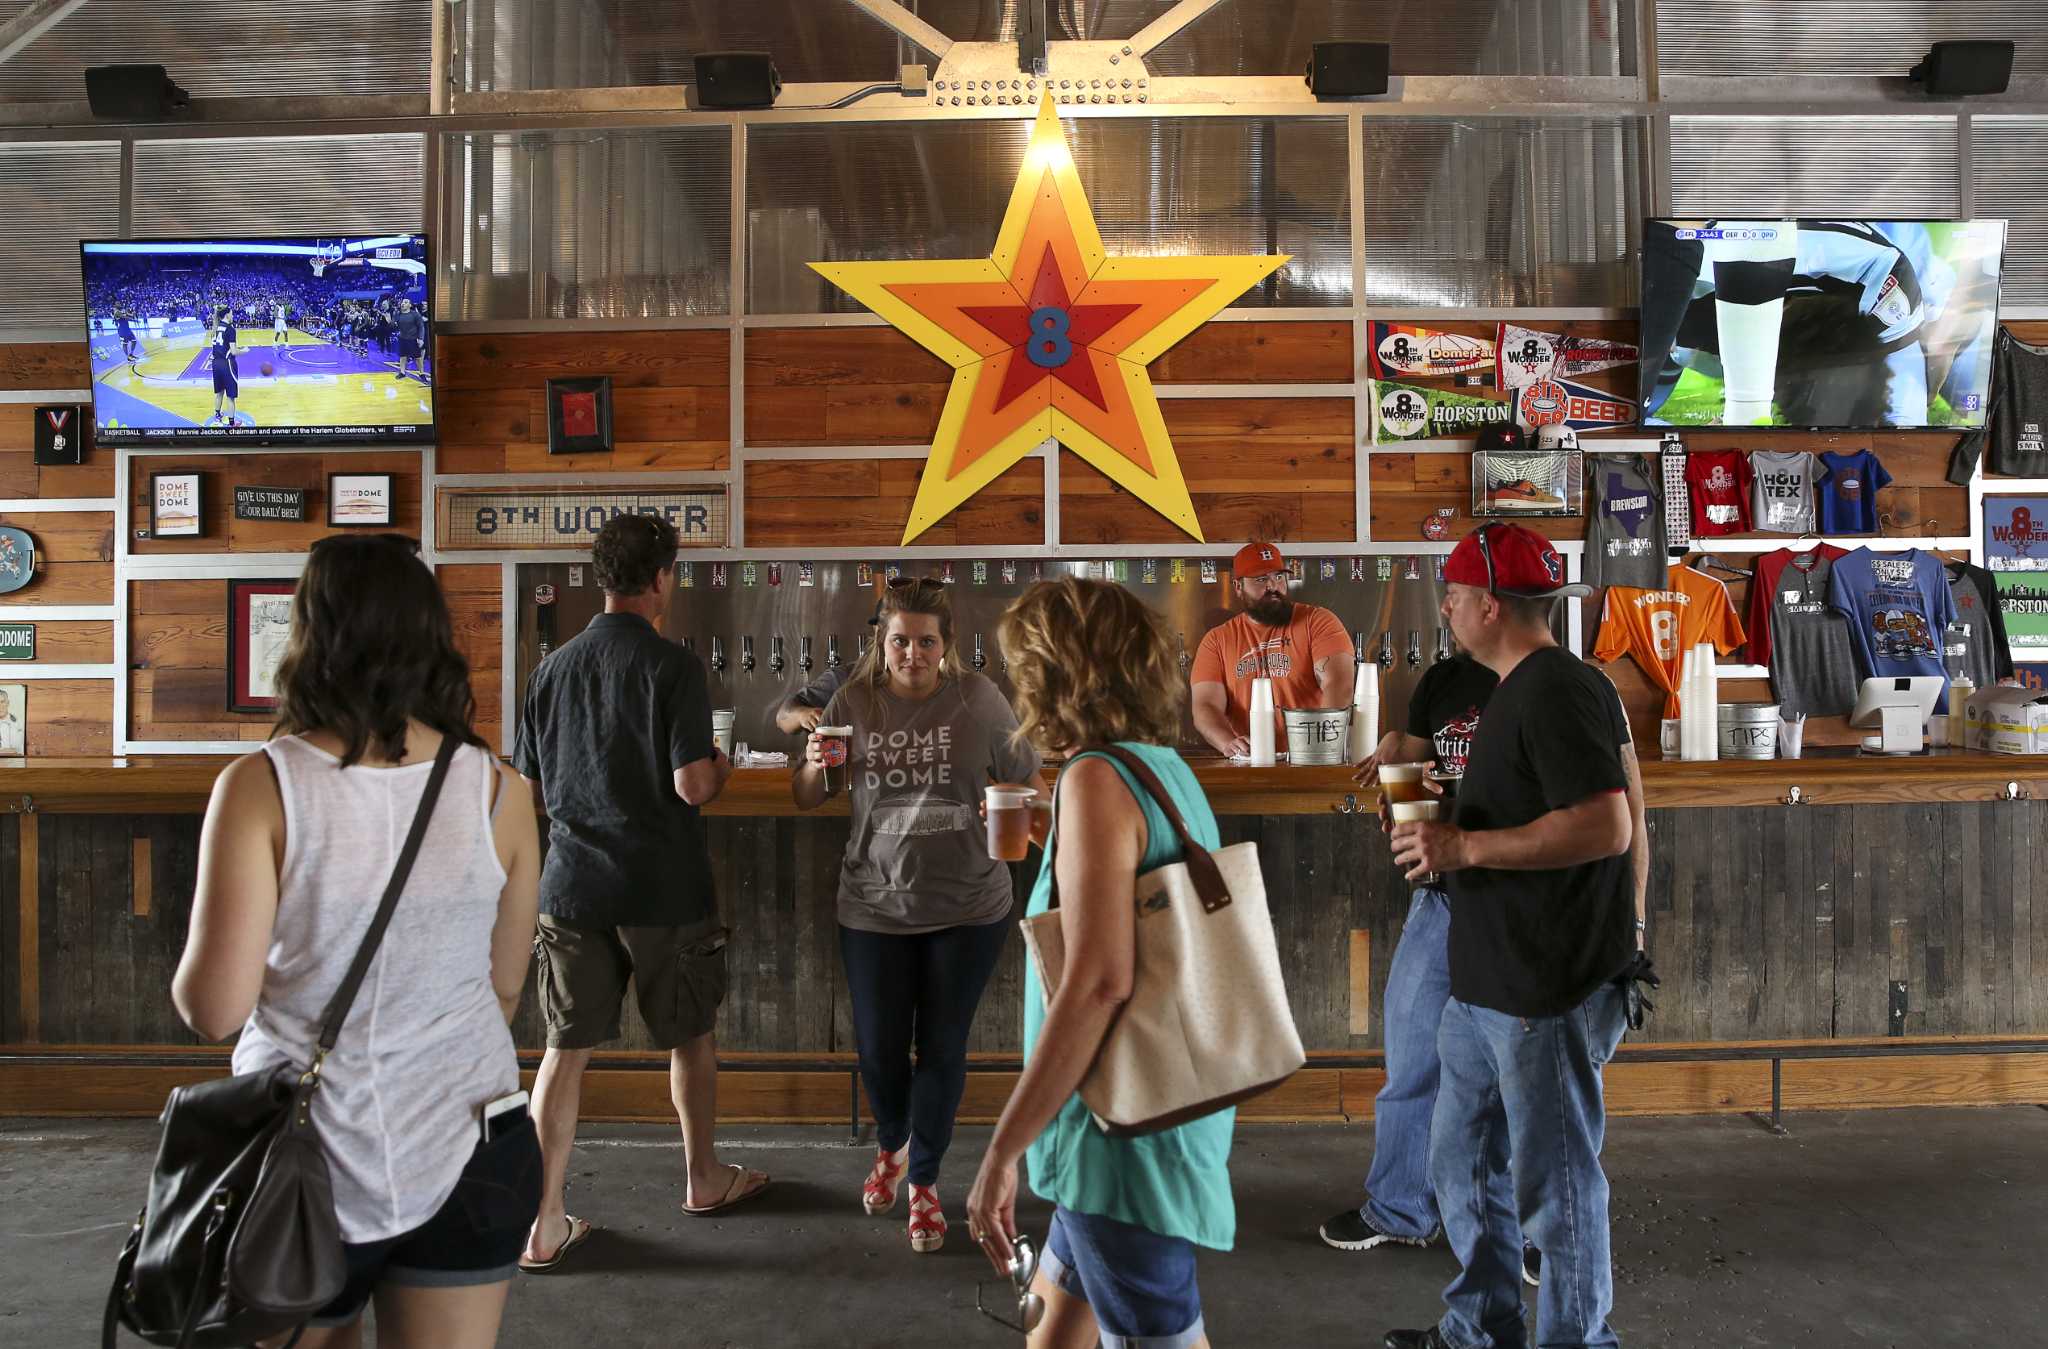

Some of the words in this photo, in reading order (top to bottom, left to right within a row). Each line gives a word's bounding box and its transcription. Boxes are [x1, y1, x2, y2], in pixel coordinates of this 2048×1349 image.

[1027, 307, 1072, 368] 8
[1380, 351, 1422, 363] WONDER
[1429, 347, 1470, 359] Dome
[1508, 351, 1551, 363] WONDER
[1382, 406, 1425, 420] WONDER
[1432, 406, 1508, 422] HOPSTON
[1570, 398, 1630, 423] BEER
[104, 428, 140, 436] BASKETBALL
[200, 429, 227, 437] Jackson,
[229, 428, 257, 436] chairman
[335, 426, 377, 434] Globetrotters,
[159, 483, 189, 491] DOME
[358, 489, 382, 497] DOME
[1766, 485, 1801, 498] TEX
[159, 498, 189, 506] DOME
[237, 491, 254, 502] GIVE
[256, 491, 266, 501] US
[266, 492, 283, 503] THIS
[284, 492, 299, 504] DAY
[248, 506, 261, 517] OUR
[262, 506, 280, 517] DAILY
[281, 507, 300, 518] BREW
[476, 506, 539, 535] 8TH
[1260, 550, 1273, 561] H
[1882, 560, 1900, 568] SALE
[1633, 591, 1690, 609] WONDER
[1651, 610, 1677, 661] 8
[867, 725, 952, 750] DOME
[1299, 719, 1341, 745] TIPS
[1727, 727, 1770, 747] TIPS
[866, 745, 952, 768] SWEET
[864, 763, 952, 790] DOME
